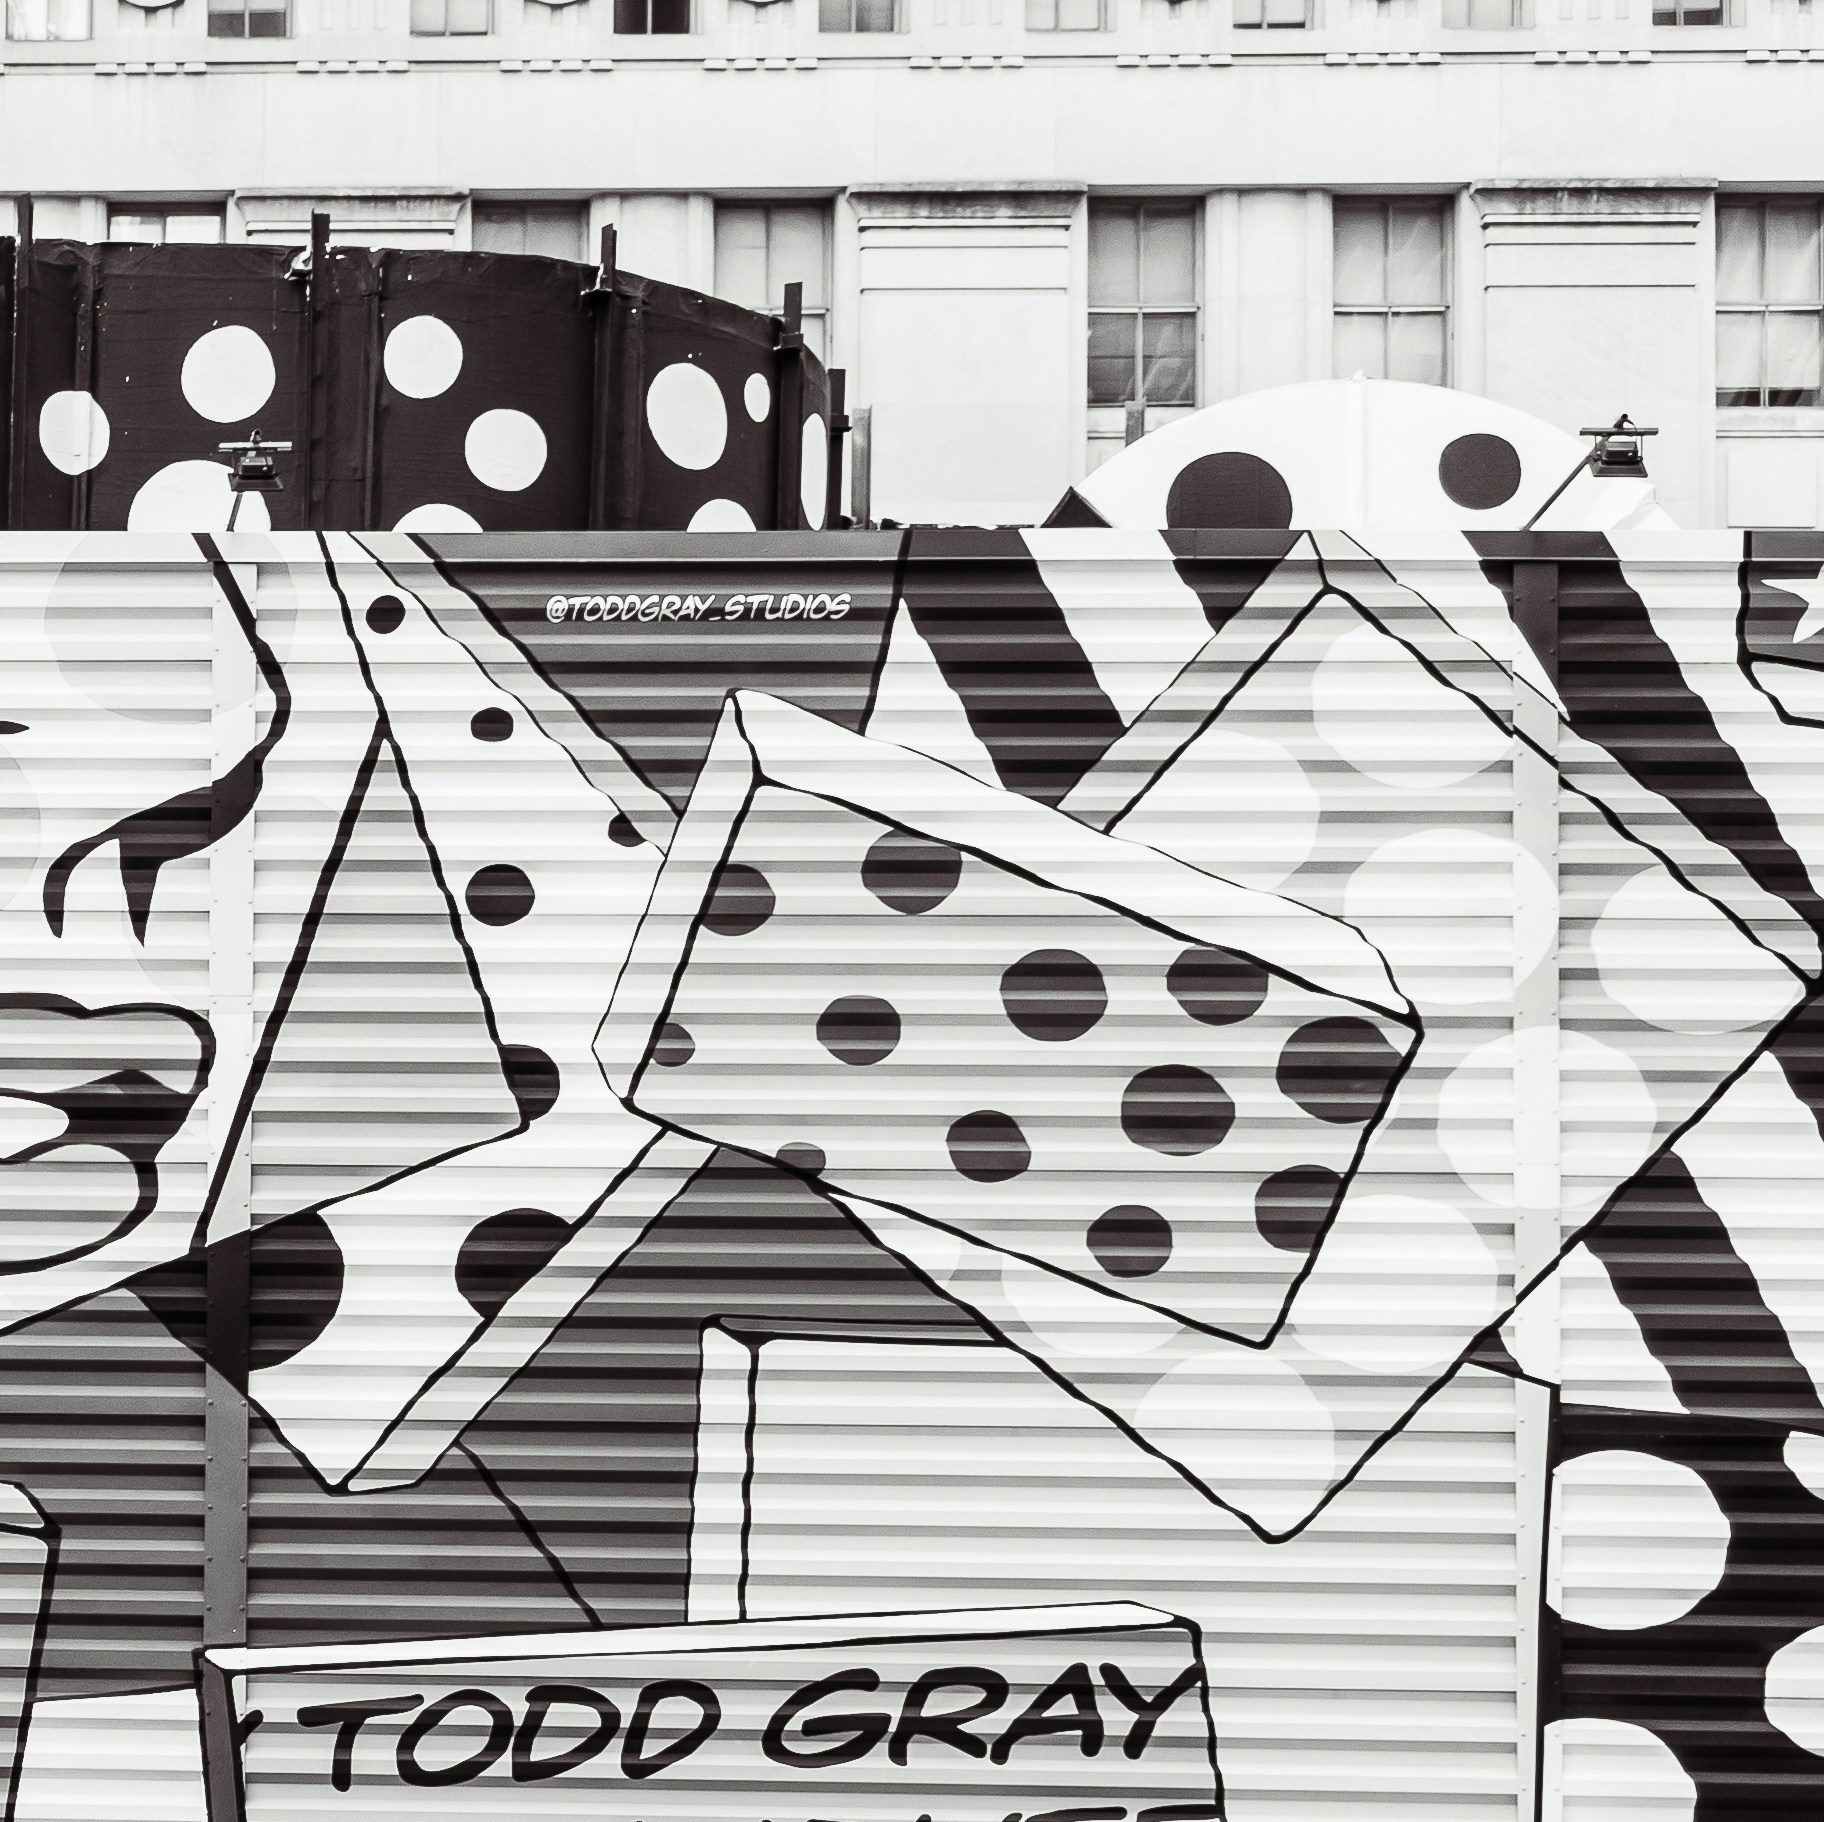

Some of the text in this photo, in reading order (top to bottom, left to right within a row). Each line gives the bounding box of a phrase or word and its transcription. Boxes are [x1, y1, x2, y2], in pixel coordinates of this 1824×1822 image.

[546, 592, 852, 624] @TODDGRAY_STUDIOS
[296, 1662, 1205, 1794] TODD GRAY
